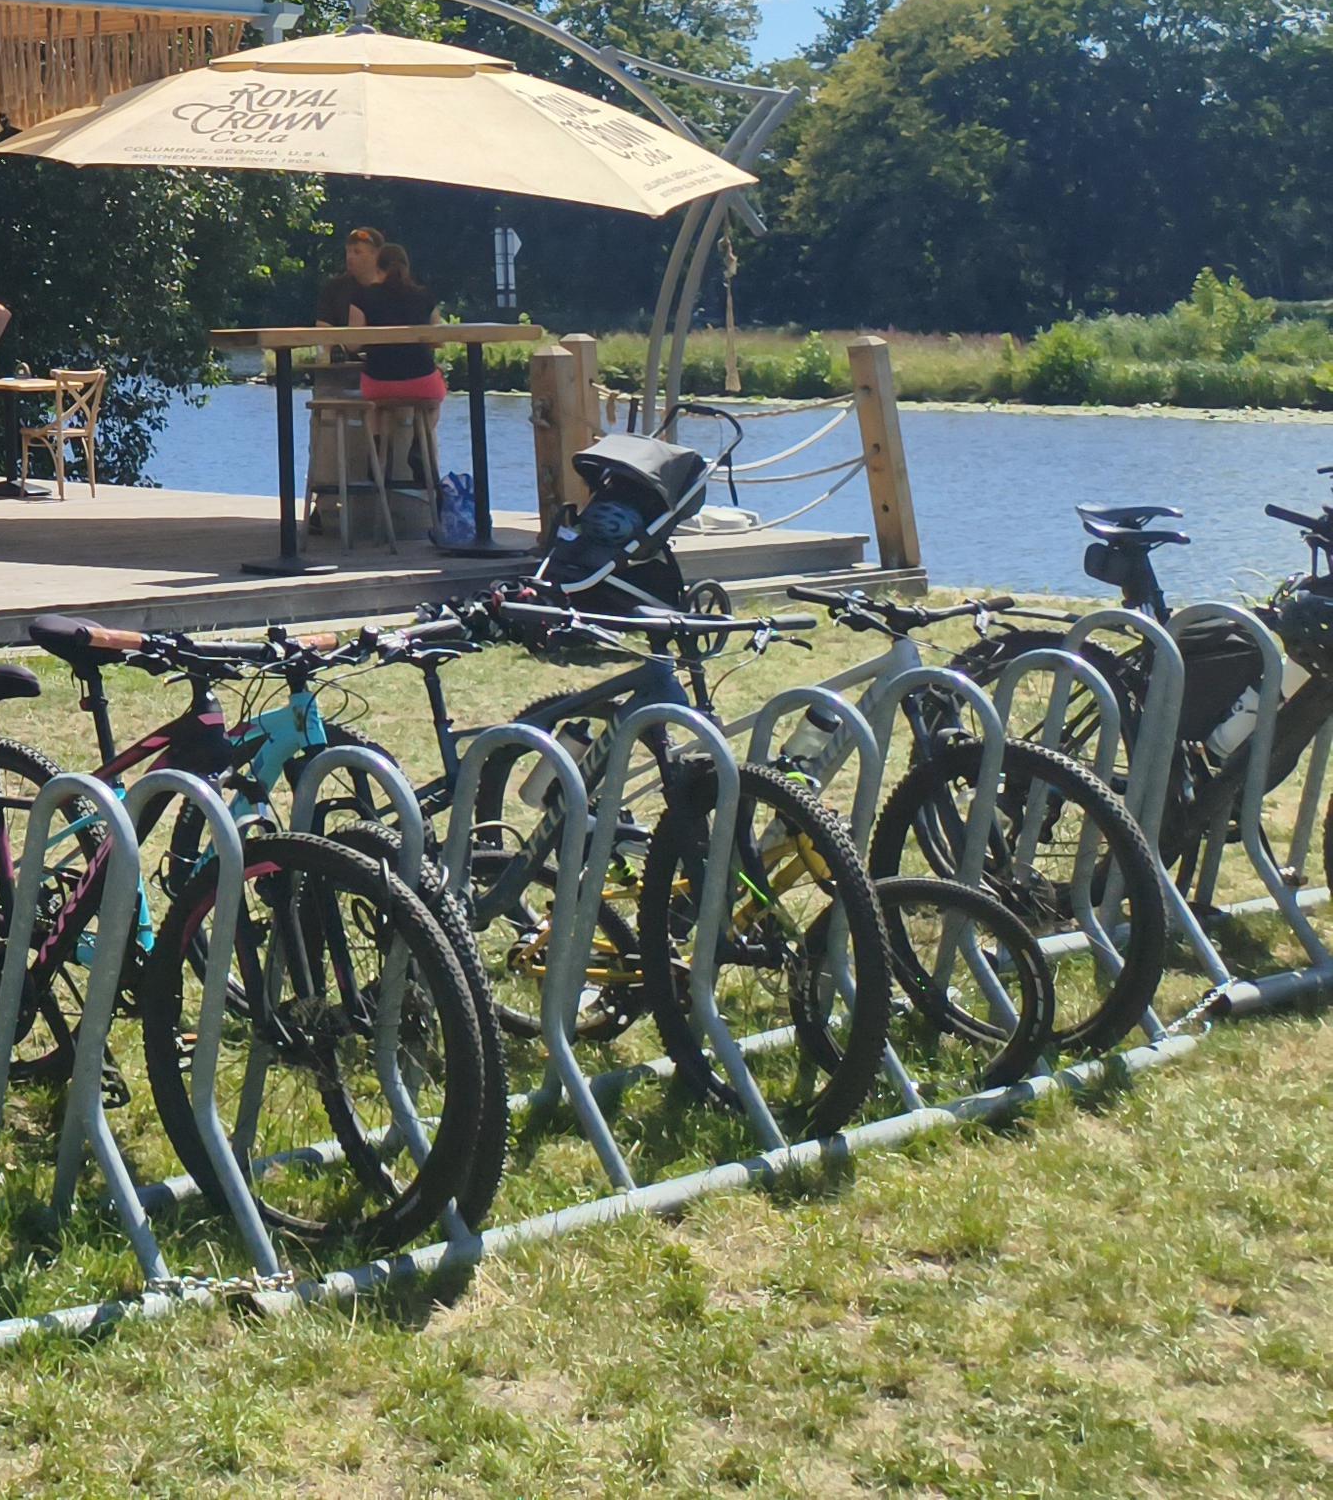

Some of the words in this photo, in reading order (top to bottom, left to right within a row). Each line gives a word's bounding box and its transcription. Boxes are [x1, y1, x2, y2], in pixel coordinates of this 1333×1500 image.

[229, 82, 338, 112] ROYAL
[172, 103, 336, 134] CROWN
[209, 130, 289, 143] Cola
